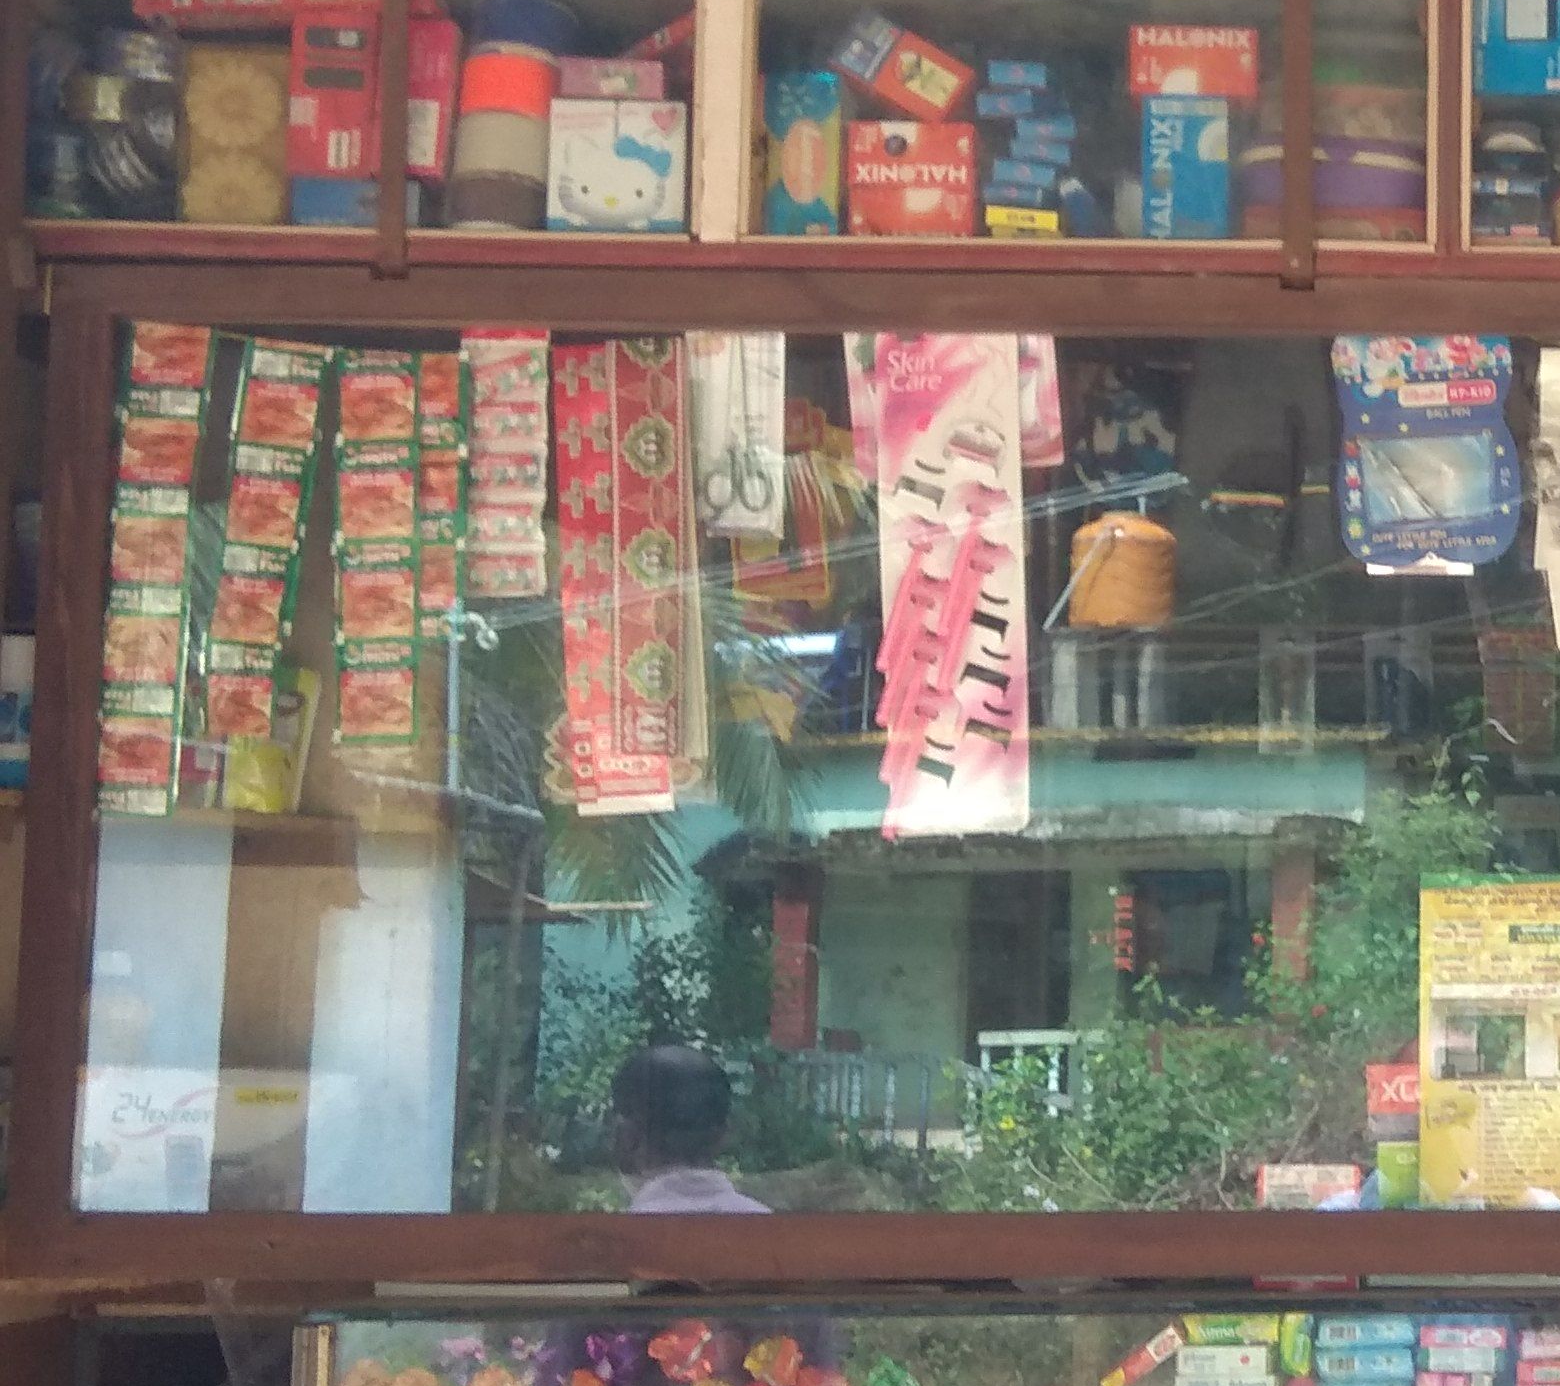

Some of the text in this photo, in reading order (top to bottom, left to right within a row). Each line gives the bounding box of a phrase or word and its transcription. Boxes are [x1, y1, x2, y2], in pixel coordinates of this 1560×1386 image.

[1136, 27, 1252, 50] HALONIX
[854, 162, 968, 185] HALONIX
[887, 349, 937, 375] Skin
[889, 372, 943, 395] Care
